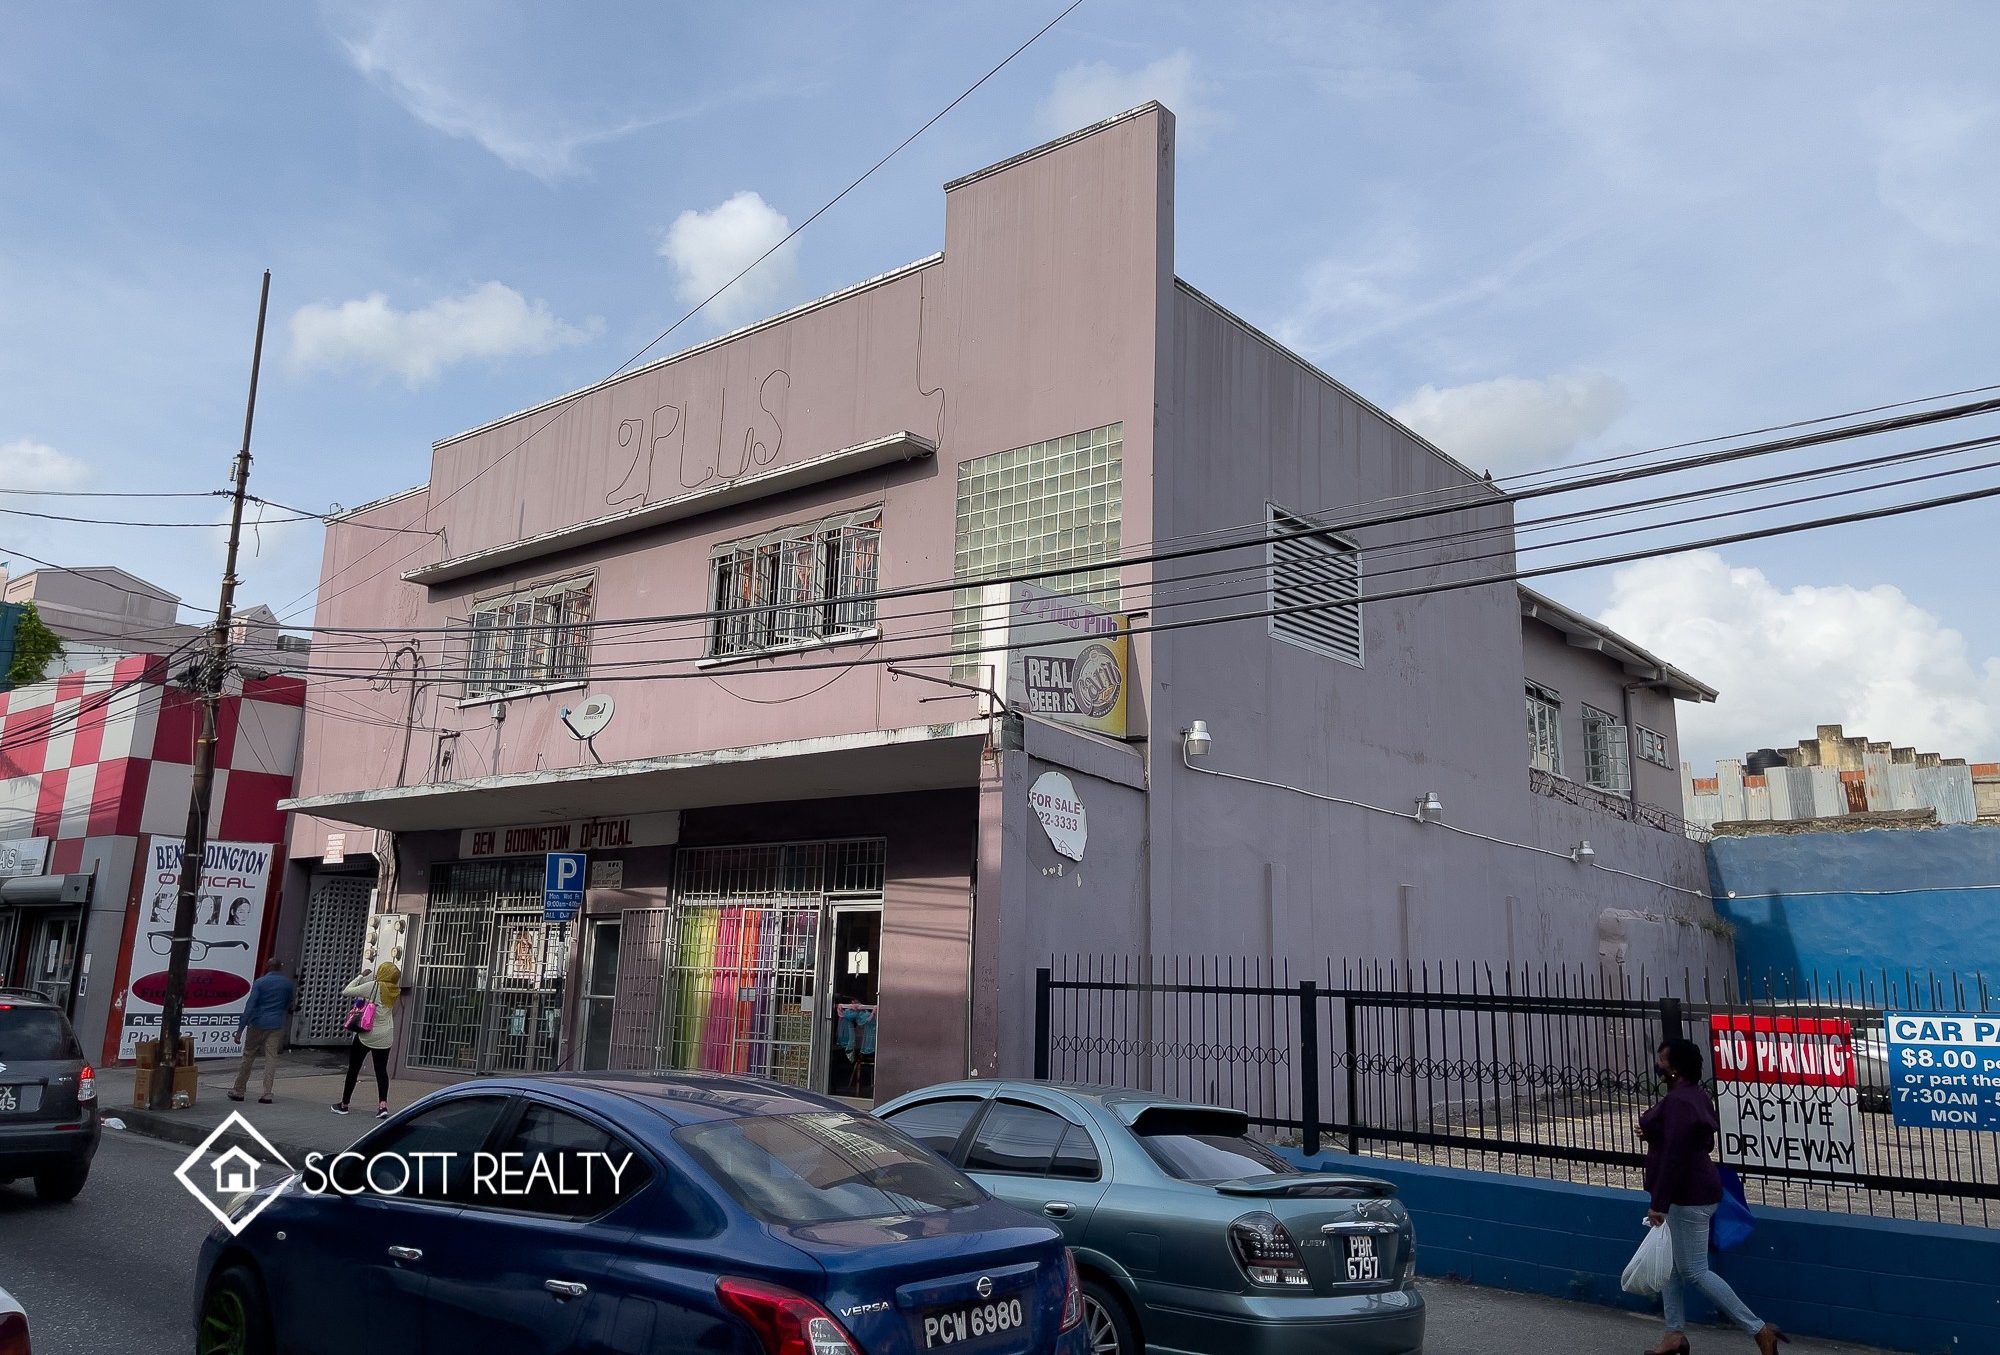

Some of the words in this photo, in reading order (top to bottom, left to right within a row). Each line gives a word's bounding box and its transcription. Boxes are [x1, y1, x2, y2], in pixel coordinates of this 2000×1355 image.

[1020, 588, 1034, 614] 2
[1038, 597, 1080, 630] Plus
[1084, 608, 1118, 642] Pub
[1028, 658, 1073, 688] REAL
[1029, 688, 1061, 712] BEER
[1064, 692, 1076, 712] IS
[1031, 791, 1052, 809] FOR
[1054, 797, 1081, 815] SALE
[472, 831, 496, 856] BEN
[504, 824, 572, 853] BODINGTON
[579, 819, 633, 848] OPTICAL
[203, 845, 268, 876] DINGTON
[158, 872, 256, 889] OTICAL
[557, 857, 578, 890] P
[133, 1016, 163, 1025] ALS
[181, 1015, 241, 1026] REPAIRS
[1895, 1020, 1963, 1042] CAR
[195, 1046, 218, 1055] THELMA
[1718, 1029, 1748, 1071] NO
[1754, 1031, 1845, 1077] PARKING
[1901, 1047, 1977, 1069] $8.00
[1904, 1074, 1924, 1084] or
[1929, 1074, 1968, 1087] part
[1897, 1087, 1978, 1106] 7:30AM
[1741, 1098, 1835, 1127] ACTIVE
[1930, 1109, 1977, 1123] MON
[1725, 1132, 1855, 1165] DRVEWAY
[1349, 1235, 1373, 1257] PBR
[1347, 1256, 1379, 1280] 6797
[840, 1301, 890, 1317] VERSA
[924, 1308, 967, 1349] PCW
[971, 1299, 1023, 1337] 6980
